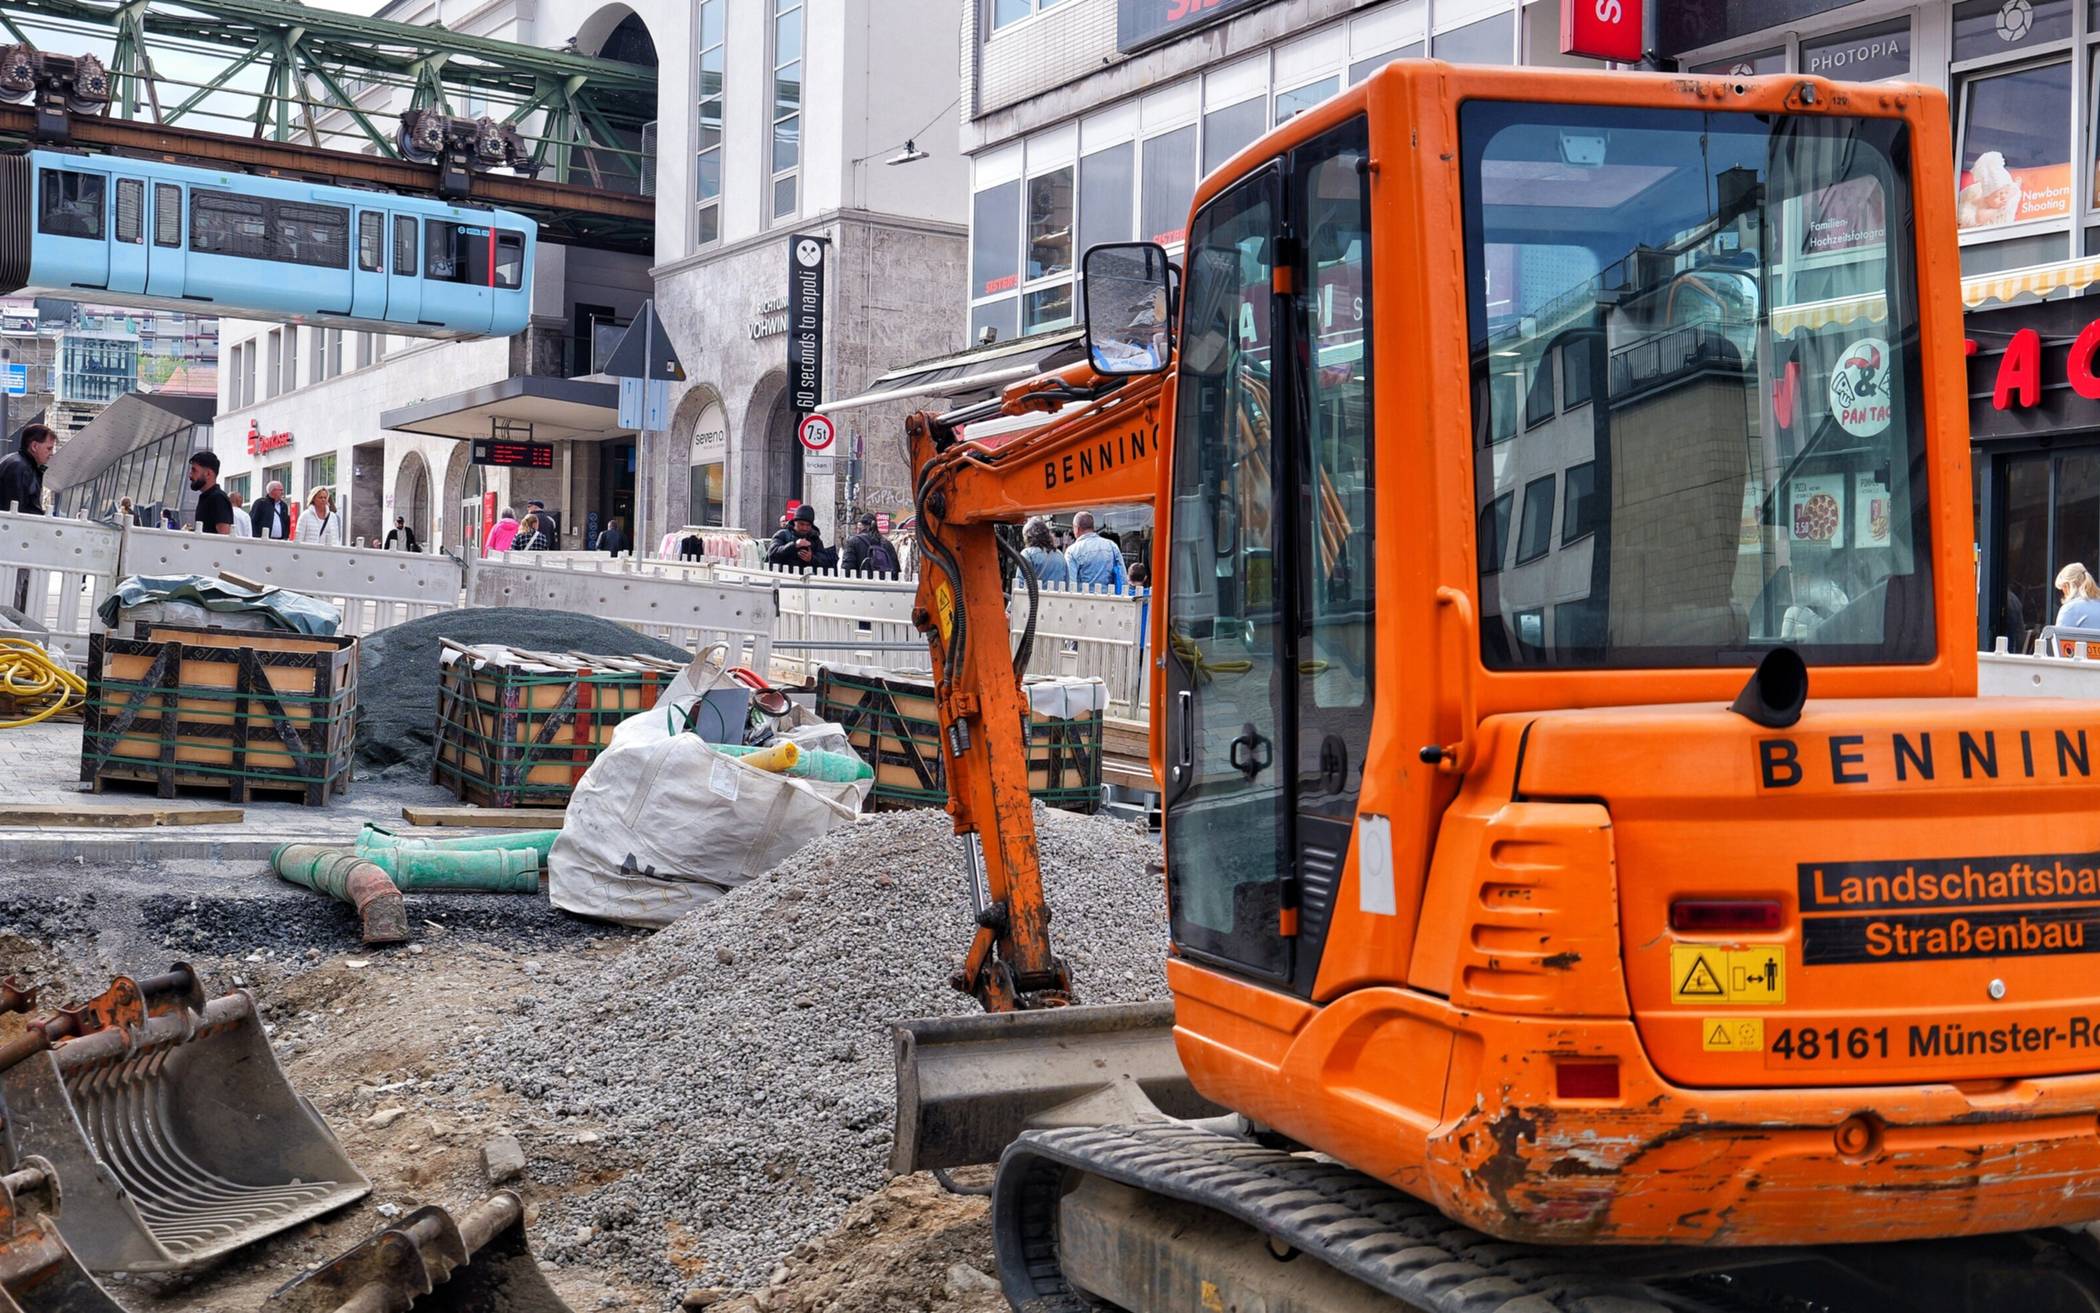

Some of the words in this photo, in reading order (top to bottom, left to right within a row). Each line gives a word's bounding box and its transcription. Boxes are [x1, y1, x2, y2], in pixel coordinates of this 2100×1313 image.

[1811, 40, 1899, 72] PHOTOPIA
[2021, 199, 2066, 213] Shooting
[757, 296, 789, 314] RICHTUN
[799, 271, 820, 313] napoli
[748, 314, 789, 340] VOHWIN
[798, 316, 816, 330] to
[798, 332, 816, 388] seconds
[797, 391, 814, 408] 60
[1842, 407, 1867, 425] PAN
[1759, 730, 2090, 789] BENNIN
[1813, 861, 2100, 905] Landschaftsba
[1865, 916, 2084, 957] Straßenbau
[1771, 1026, 1888, 1060] 48161
